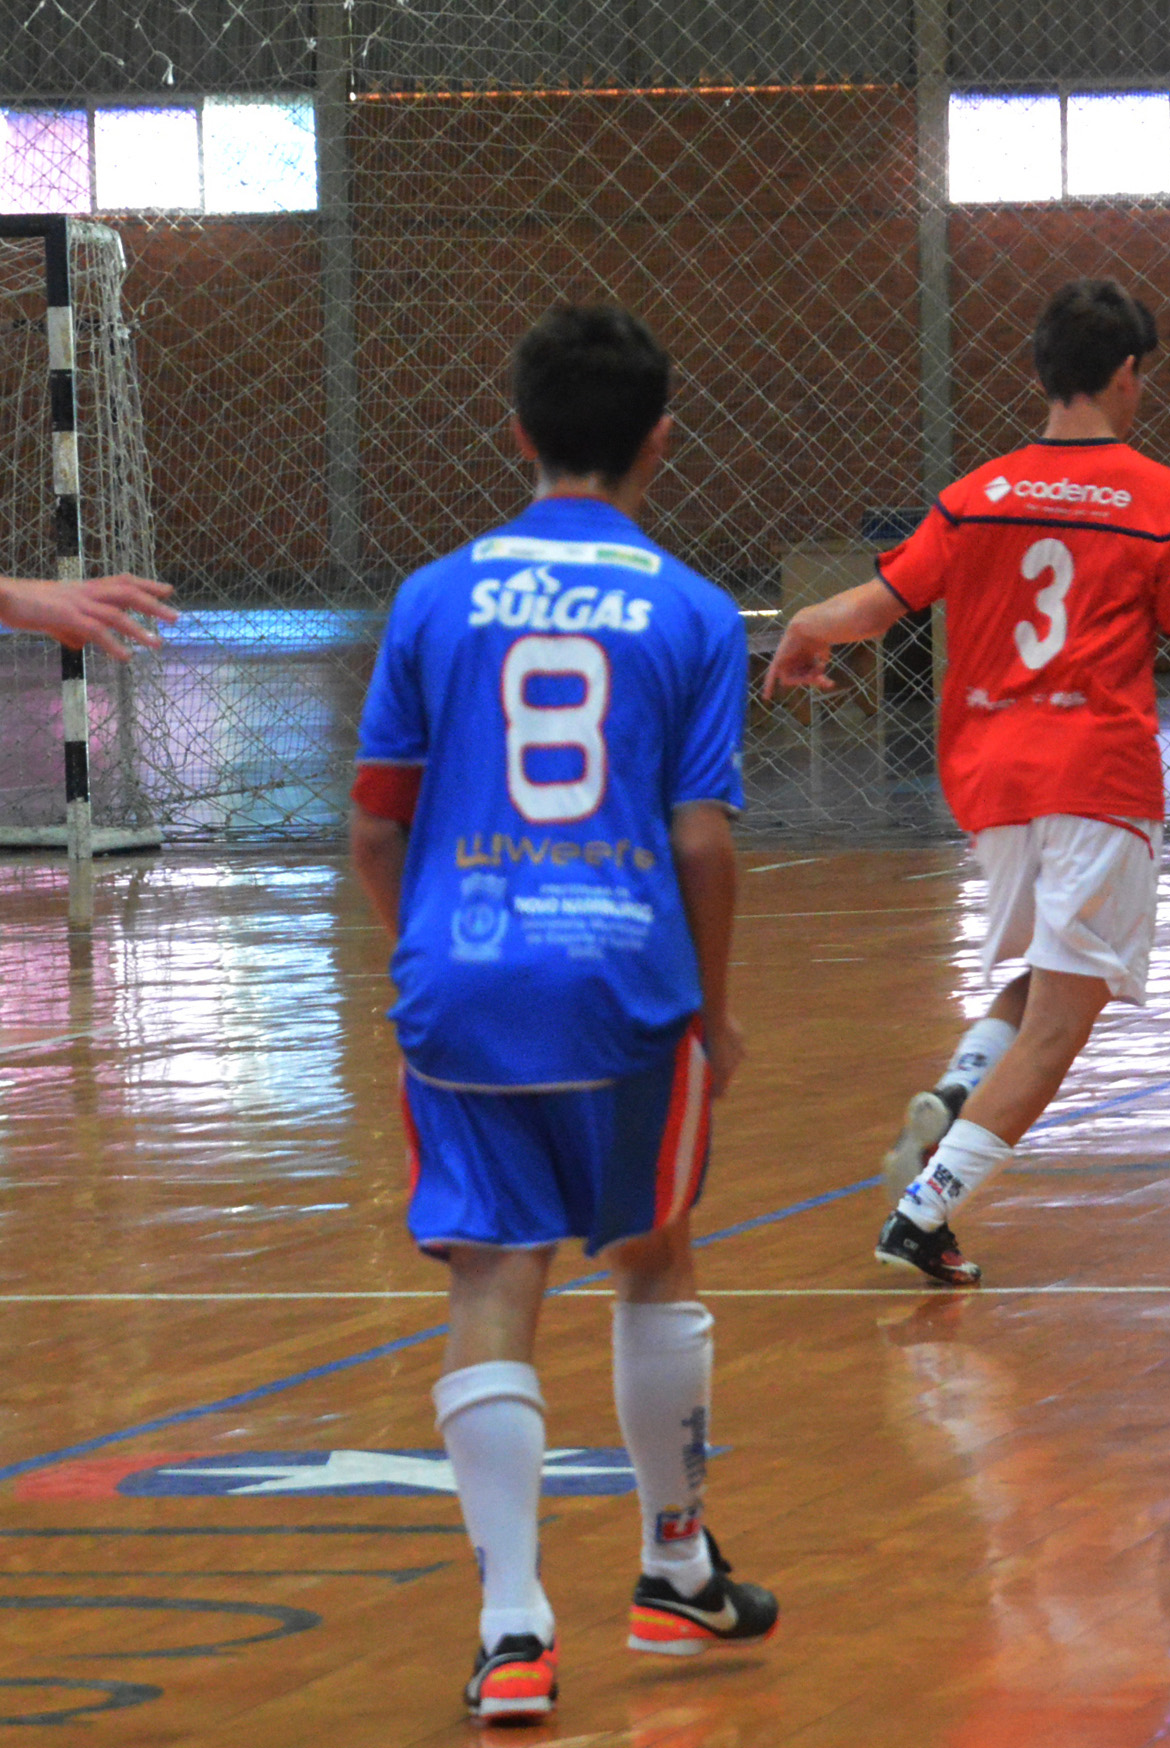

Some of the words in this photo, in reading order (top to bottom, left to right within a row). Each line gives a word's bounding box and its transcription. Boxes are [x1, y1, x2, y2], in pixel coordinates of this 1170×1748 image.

[1014, 478, 1132, 508] cadence
[1014, 537, 1075, 670] 3
[500, 633, 612, 825] 8
